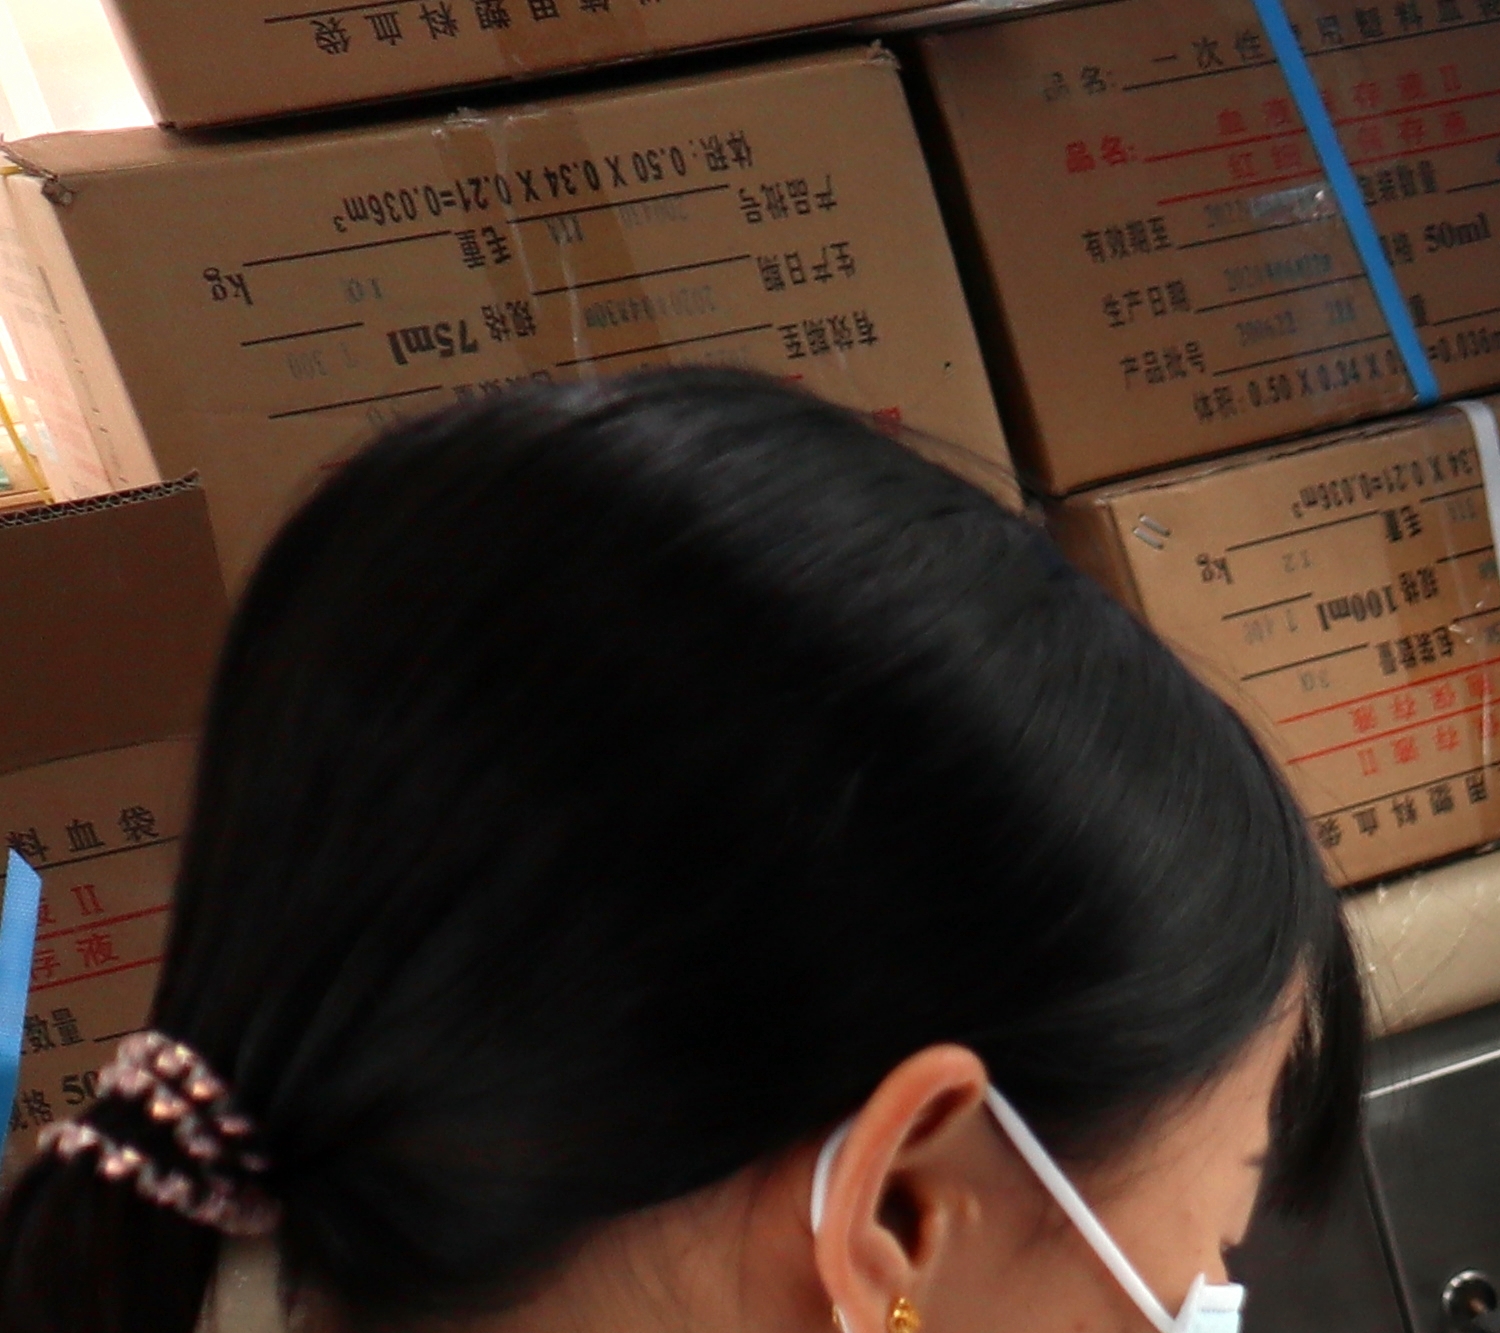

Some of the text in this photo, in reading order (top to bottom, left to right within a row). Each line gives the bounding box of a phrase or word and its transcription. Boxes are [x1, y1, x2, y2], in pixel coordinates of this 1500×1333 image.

[311, 0, 661, 56] 用塑料血袋
[455, 226, 512, 270] 毛重
[1423, 211, 1491, 254] 50ml
[203, 266, 254, 308] kg
[757, 241, 857, 294] 生产日期
[481, 299, 536, 342] 规格
[386, 320, 478, 367] 75ml
[1194, 553, 1235, 586] kg
[1315, 585, 1399, 633] 100ml
